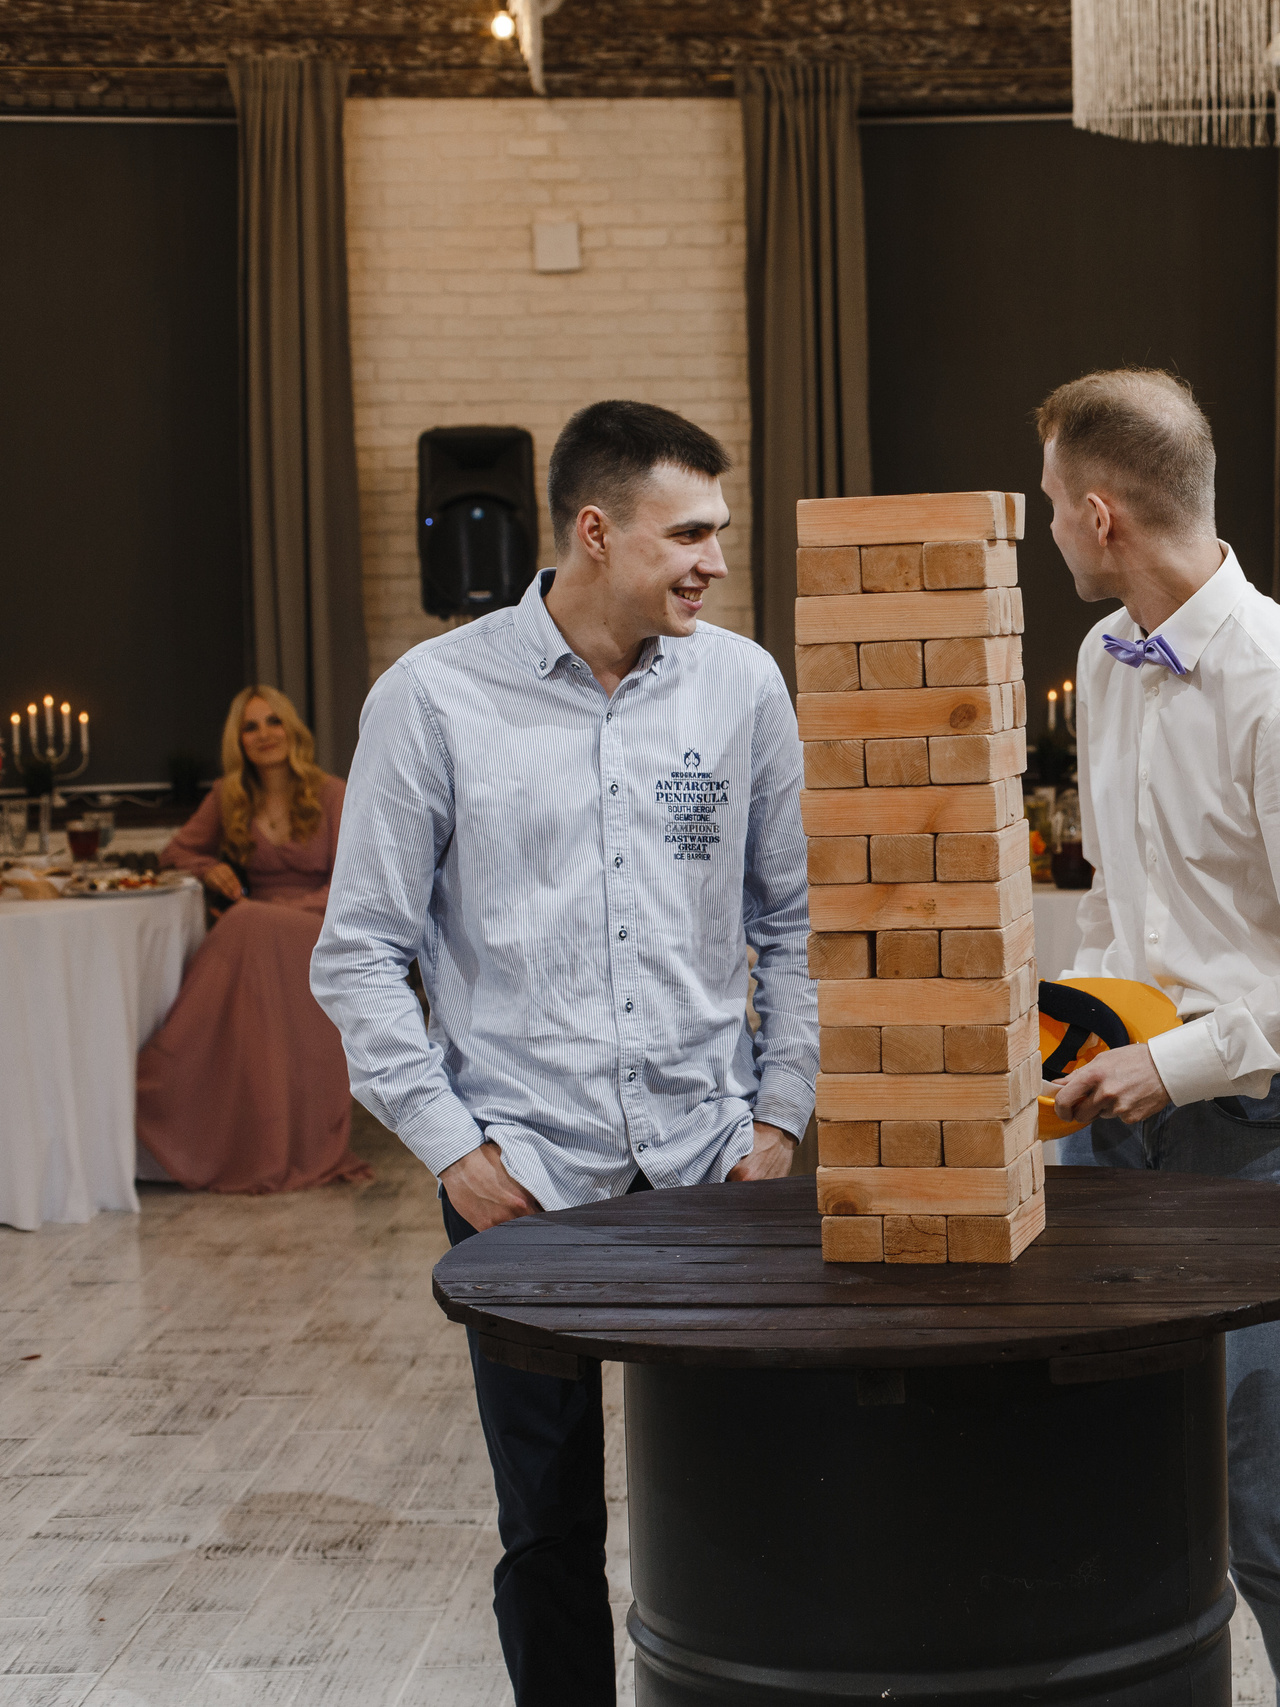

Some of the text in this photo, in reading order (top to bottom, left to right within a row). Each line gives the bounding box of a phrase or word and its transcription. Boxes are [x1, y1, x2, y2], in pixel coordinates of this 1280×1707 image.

[655, 780, 730, 792] ANTARCTIC
[655, 792, 729, 803] PENINSULA
[674, 814, 710, 822] GEMSTONE
[664, 824, 720, 833] CAMPIONE
[664, 835, 720, 844] EASTWARDS
[678, 843, 708, 852] GREAT
[687, 853, 711, 861] BARRIER
